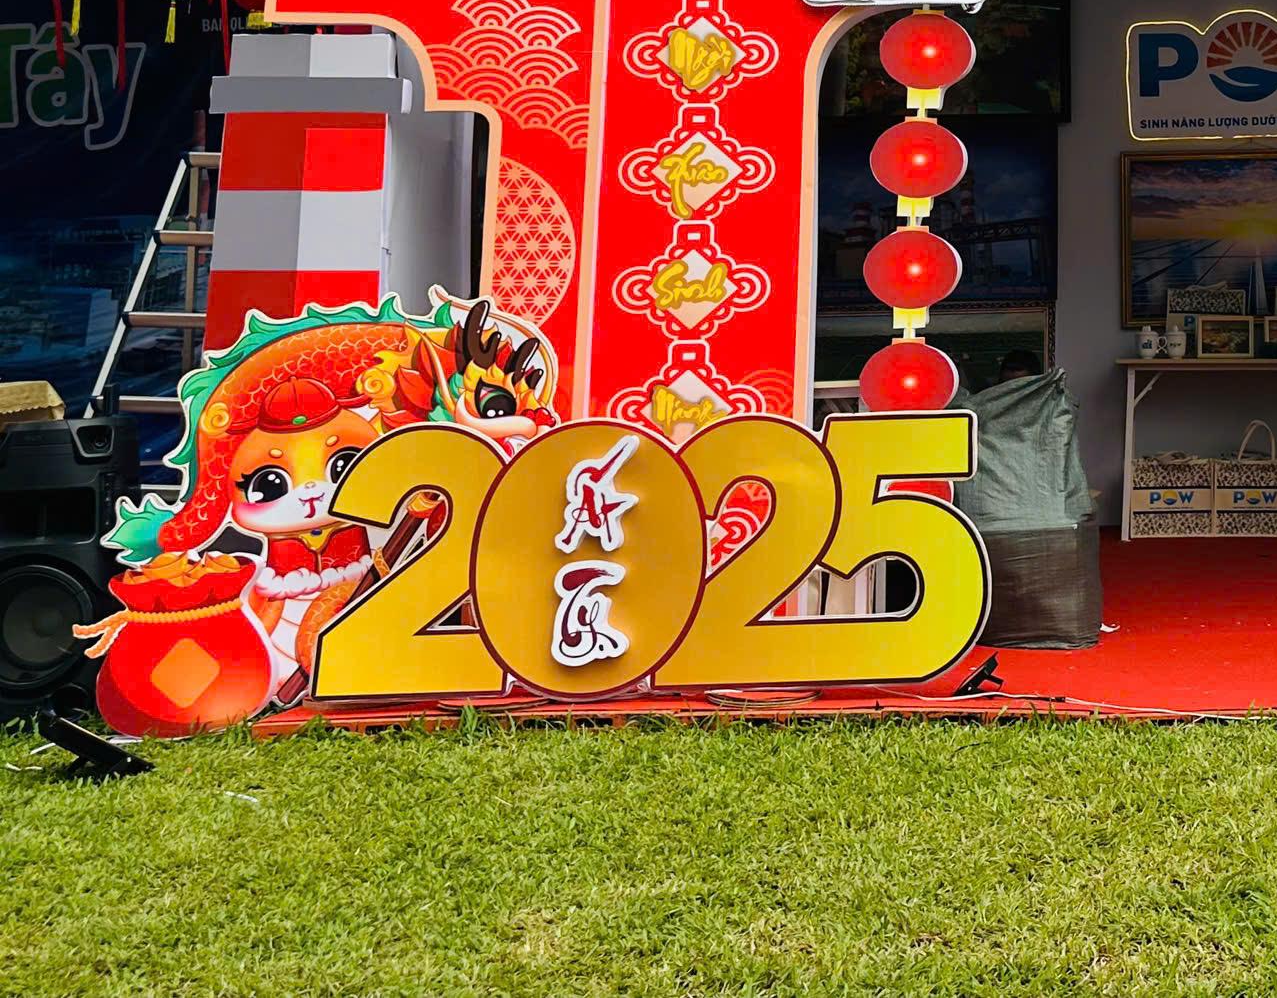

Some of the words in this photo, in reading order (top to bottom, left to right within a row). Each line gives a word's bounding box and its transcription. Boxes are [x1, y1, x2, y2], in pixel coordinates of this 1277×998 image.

[1140, 119, 1168, 129] SINH
[653, 260, 728, 310] Sinh
[310, 412, 991, 699] 2025
